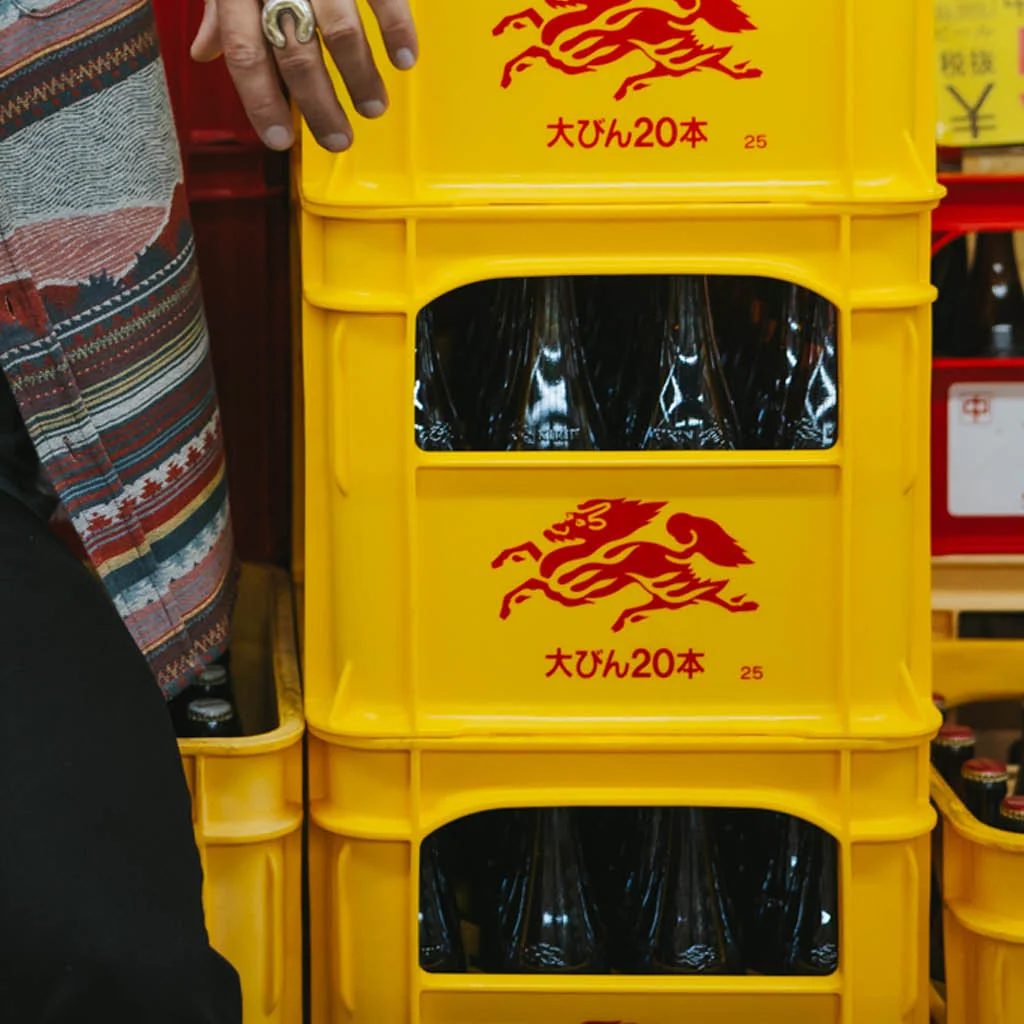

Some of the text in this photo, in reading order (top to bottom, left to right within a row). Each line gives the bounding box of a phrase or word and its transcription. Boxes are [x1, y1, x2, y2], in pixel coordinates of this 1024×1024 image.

[546, 116, 768, 149] 大びん20本 25
[544, 647, 764, 680] 大びん20本 25
